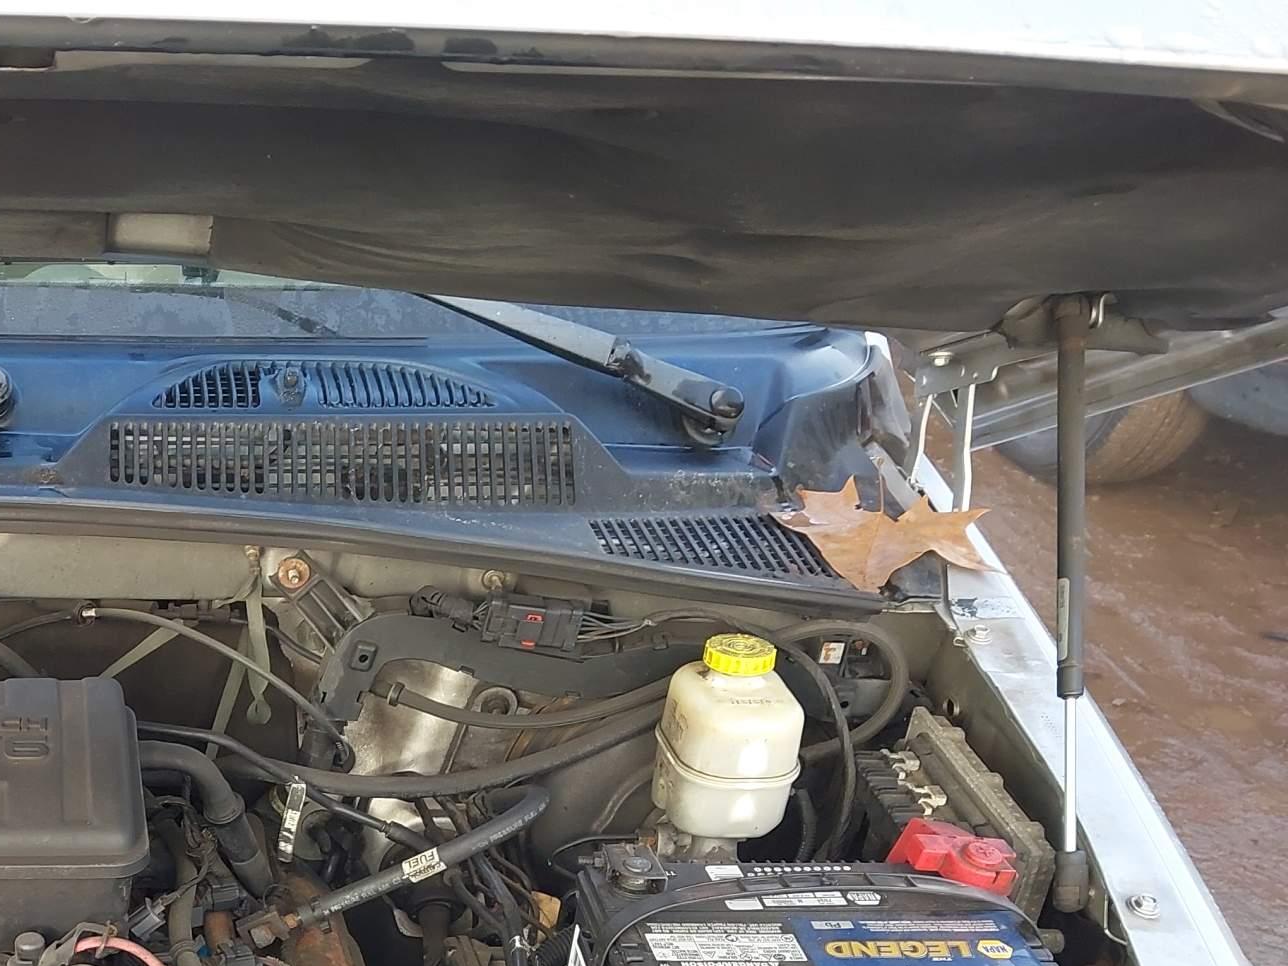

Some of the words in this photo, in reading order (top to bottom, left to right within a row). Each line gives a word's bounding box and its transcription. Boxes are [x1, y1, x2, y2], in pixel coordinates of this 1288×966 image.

[407, 850, 435, 869] FUEL
[825, 939, 975, 958] LEGEND
[981, 944, 1009, 953] NAPA
